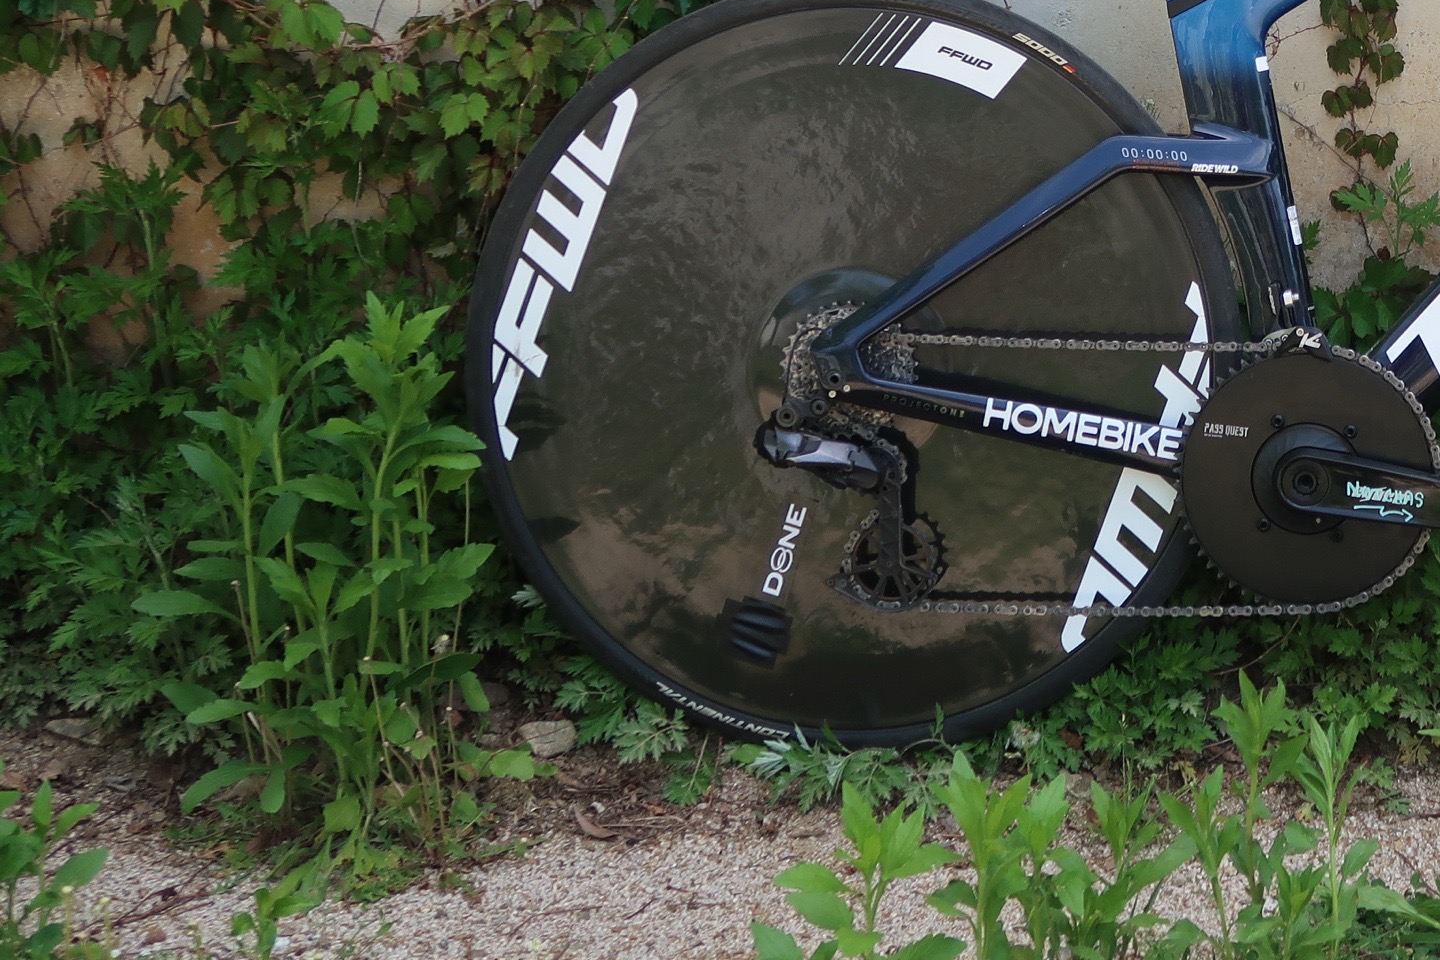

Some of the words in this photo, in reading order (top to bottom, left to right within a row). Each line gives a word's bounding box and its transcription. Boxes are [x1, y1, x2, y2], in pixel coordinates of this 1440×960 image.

[937, 45, 993, 71] FFWD
[1012, 32, 1068, 66] 5000
[1121, 147, 1188, 162] 00:00:00
[983, 397, 1183, 461] HOMEBIKE
[762, 503, 807, 597] DONE
[656, 681, 791, 739] CONTINENTAL
